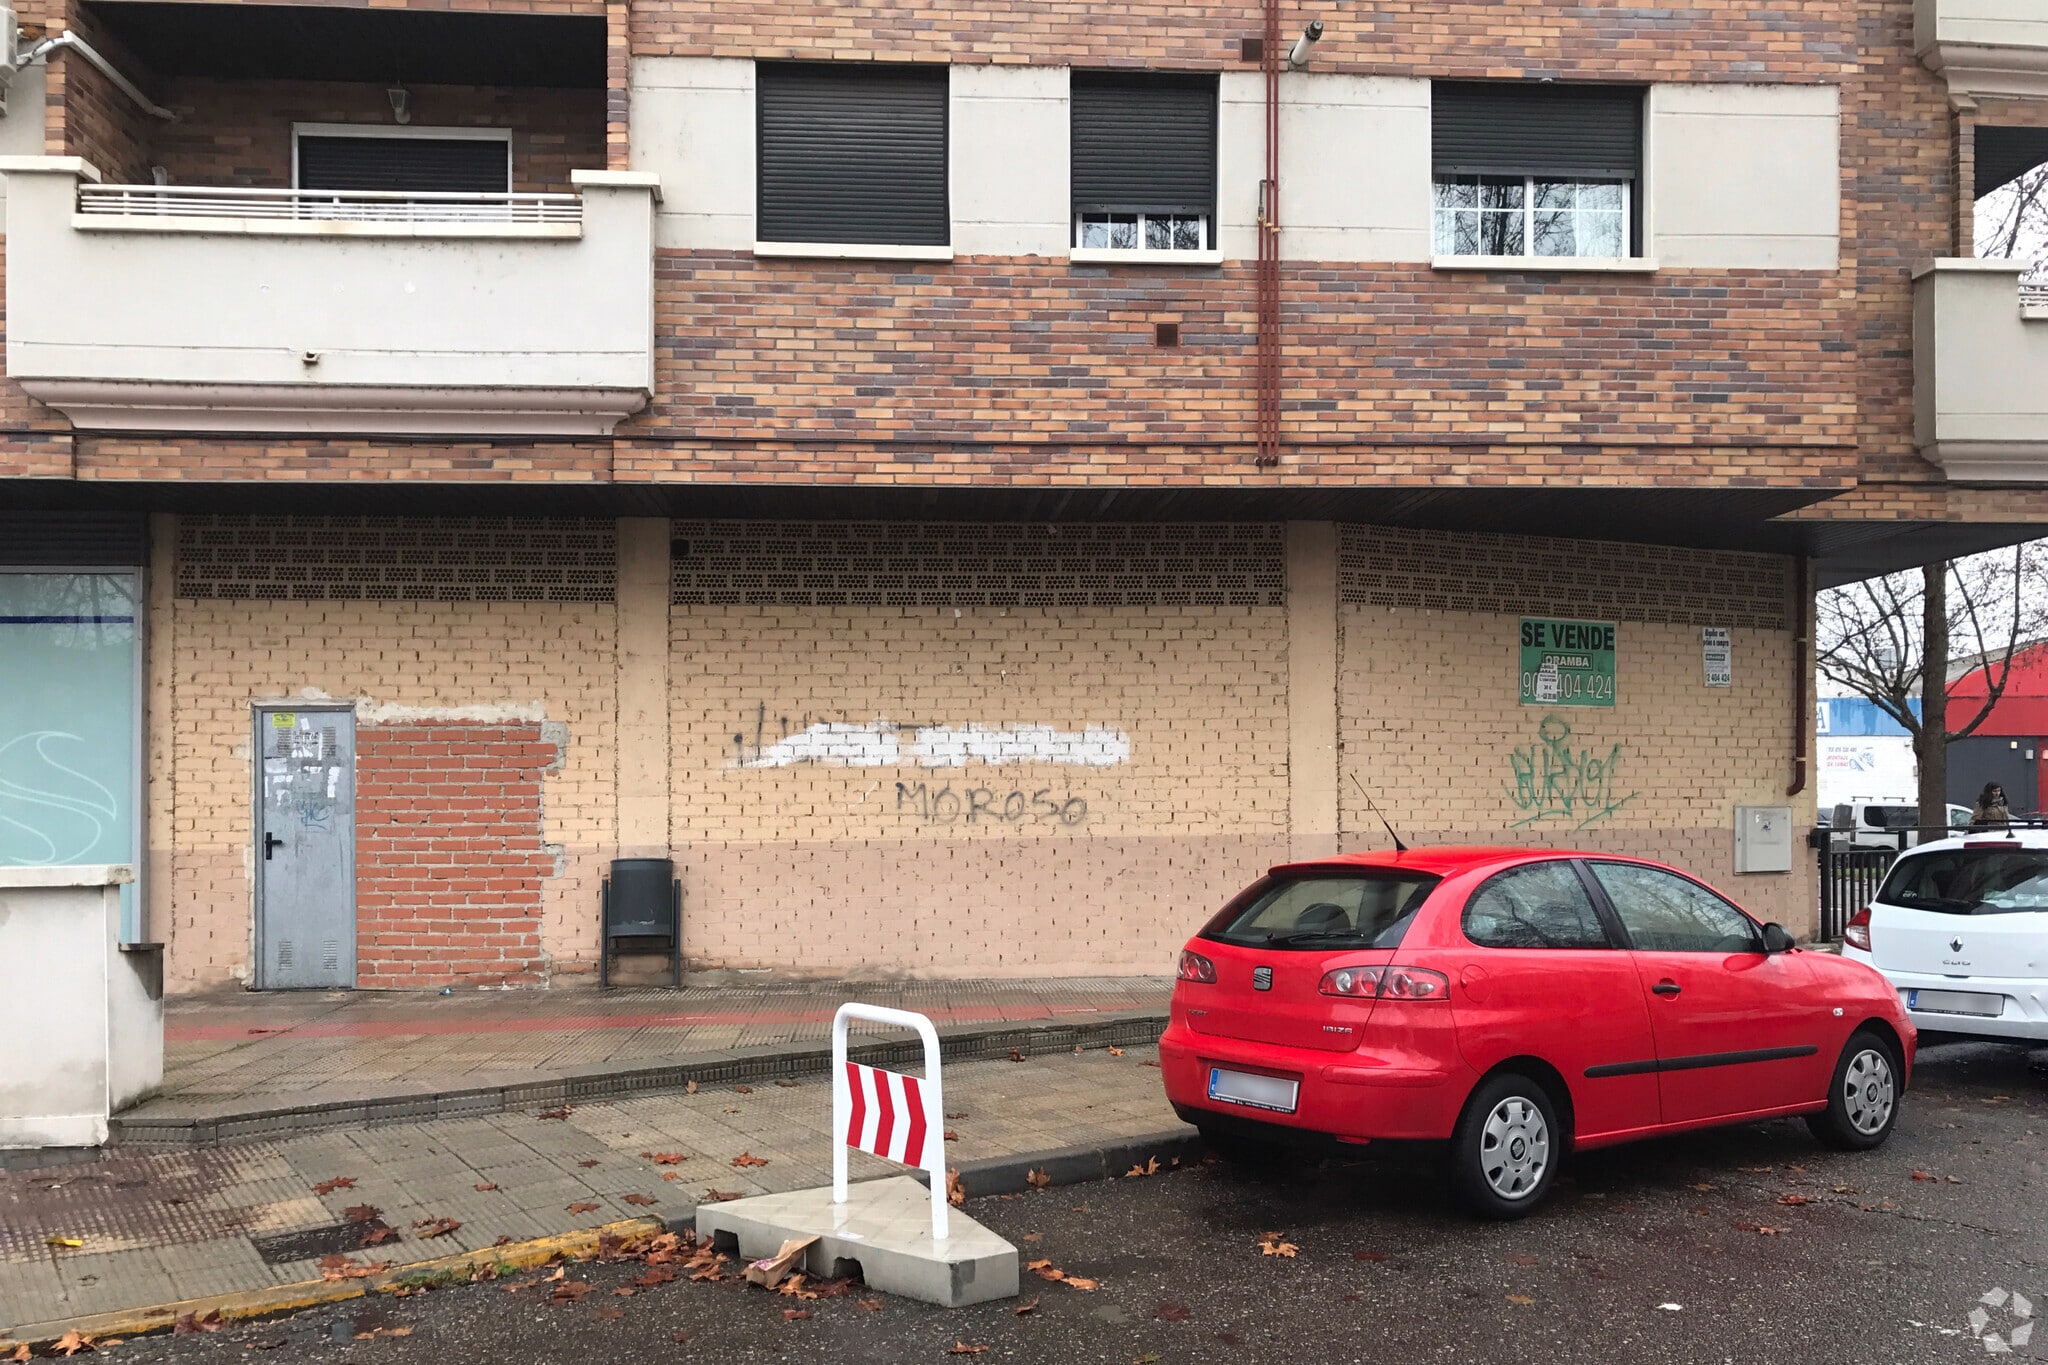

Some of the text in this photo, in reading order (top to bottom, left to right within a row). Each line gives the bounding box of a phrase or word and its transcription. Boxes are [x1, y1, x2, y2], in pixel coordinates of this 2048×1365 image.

[1521, 622, 1615, 651] SE VENDE
[1545, 655, 1589, 667] ORAMBA
[1523, 672, 1540, 697] 90
[1587, 674, 1612, 699] 424
[895, 781, 1088, 827] MOROSO
[1322, 1025, 1353, 1033] IBIZA
